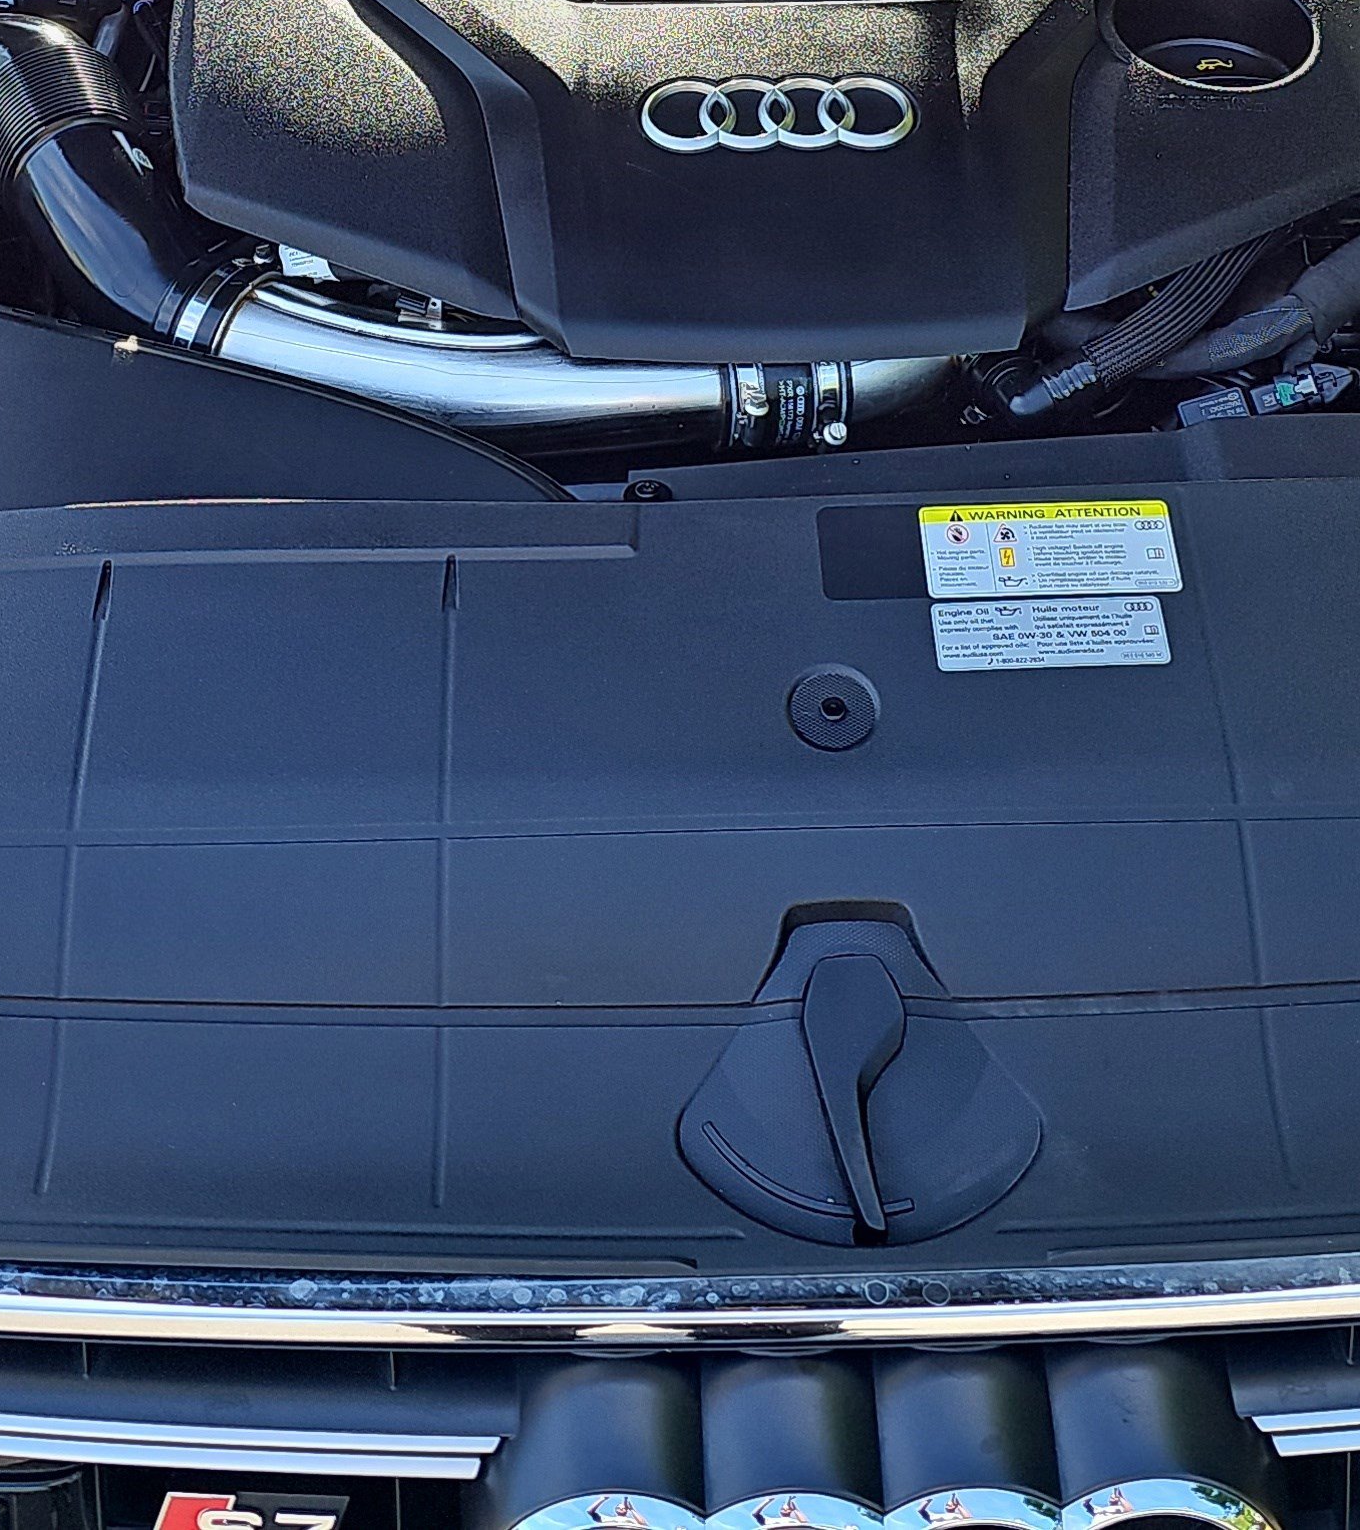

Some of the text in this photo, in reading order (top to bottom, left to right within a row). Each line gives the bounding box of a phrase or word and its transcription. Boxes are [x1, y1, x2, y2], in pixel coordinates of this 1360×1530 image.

[968, 507, 1140, 520] WARNING ATTENTION
[938, 610, 972, 618] Engine
[992, 633, 1015, 641] SAE
[1018, 631, 1053, 639] 0W-30
[1068, 630, 1088, 638] VW
[1113, 629, 1127, 637] 00
[981, 643, 1013, 651] approved
